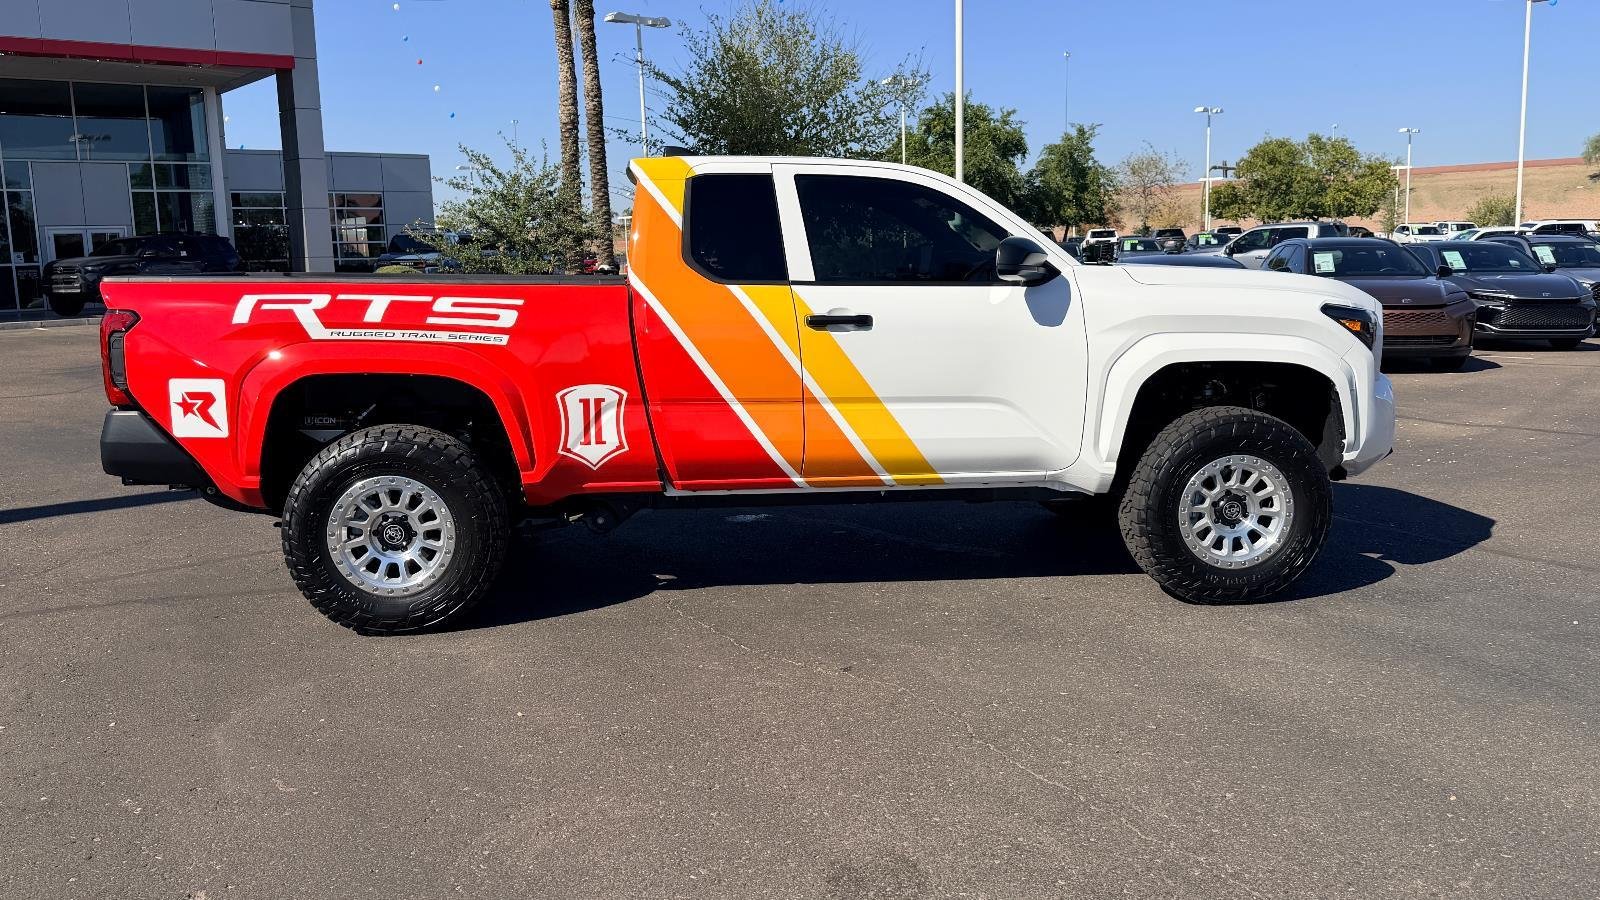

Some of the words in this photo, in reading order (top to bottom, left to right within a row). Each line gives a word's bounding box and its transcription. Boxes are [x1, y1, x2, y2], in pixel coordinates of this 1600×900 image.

[232, 294, 525, 340] RTS
[447, 333, 503, 343] SERIES
[314, 416, 336, 424] ICON
